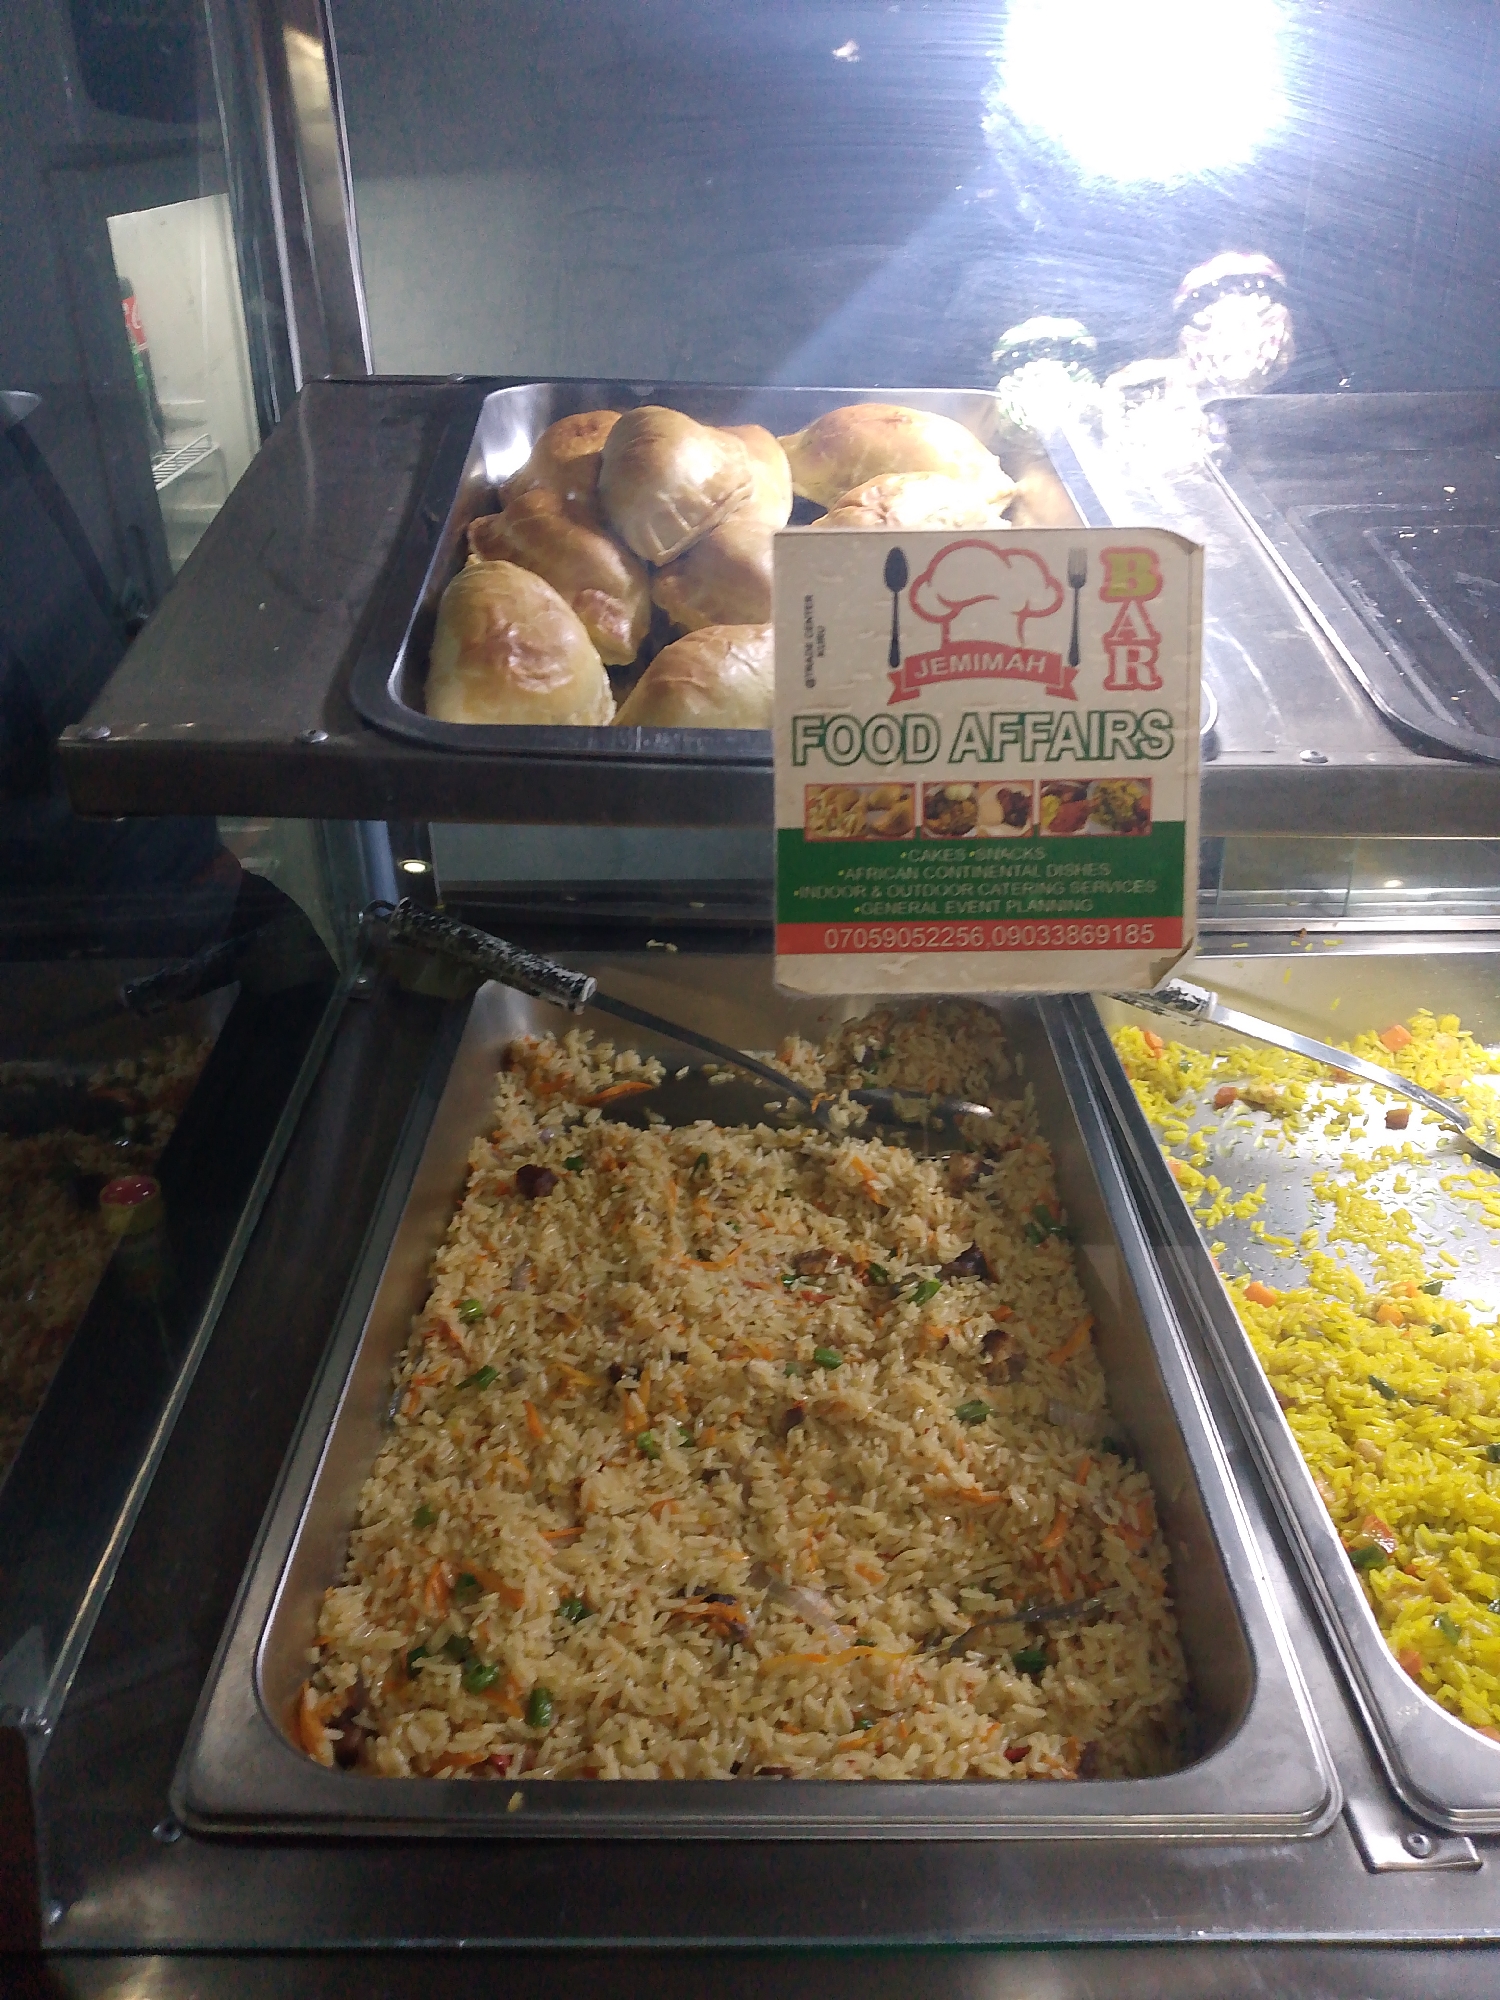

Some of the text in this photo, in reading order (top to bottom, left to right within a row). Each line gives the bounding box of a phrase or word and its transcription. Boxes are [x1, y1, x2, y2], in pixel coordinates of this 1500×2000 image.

[804, 595, 814, 639] CENTER
[1101, 547, 1163, 691] BAR
[914, 651, 1046, 680] JEMIMAH
[791, 709, 1174, 767] FOOD AFFAIRS
[907, 846, 1046, 862] CAKES SNACKS
[844, 863, 1111, 880] AFRICAN CONTINENTAL DISHES
[799, 879, 1157, 899] INDOOR & OUTDOOR CATERING SERVICES
[860, 898, 1094, 915] GENERAL EVENT PLANNING
